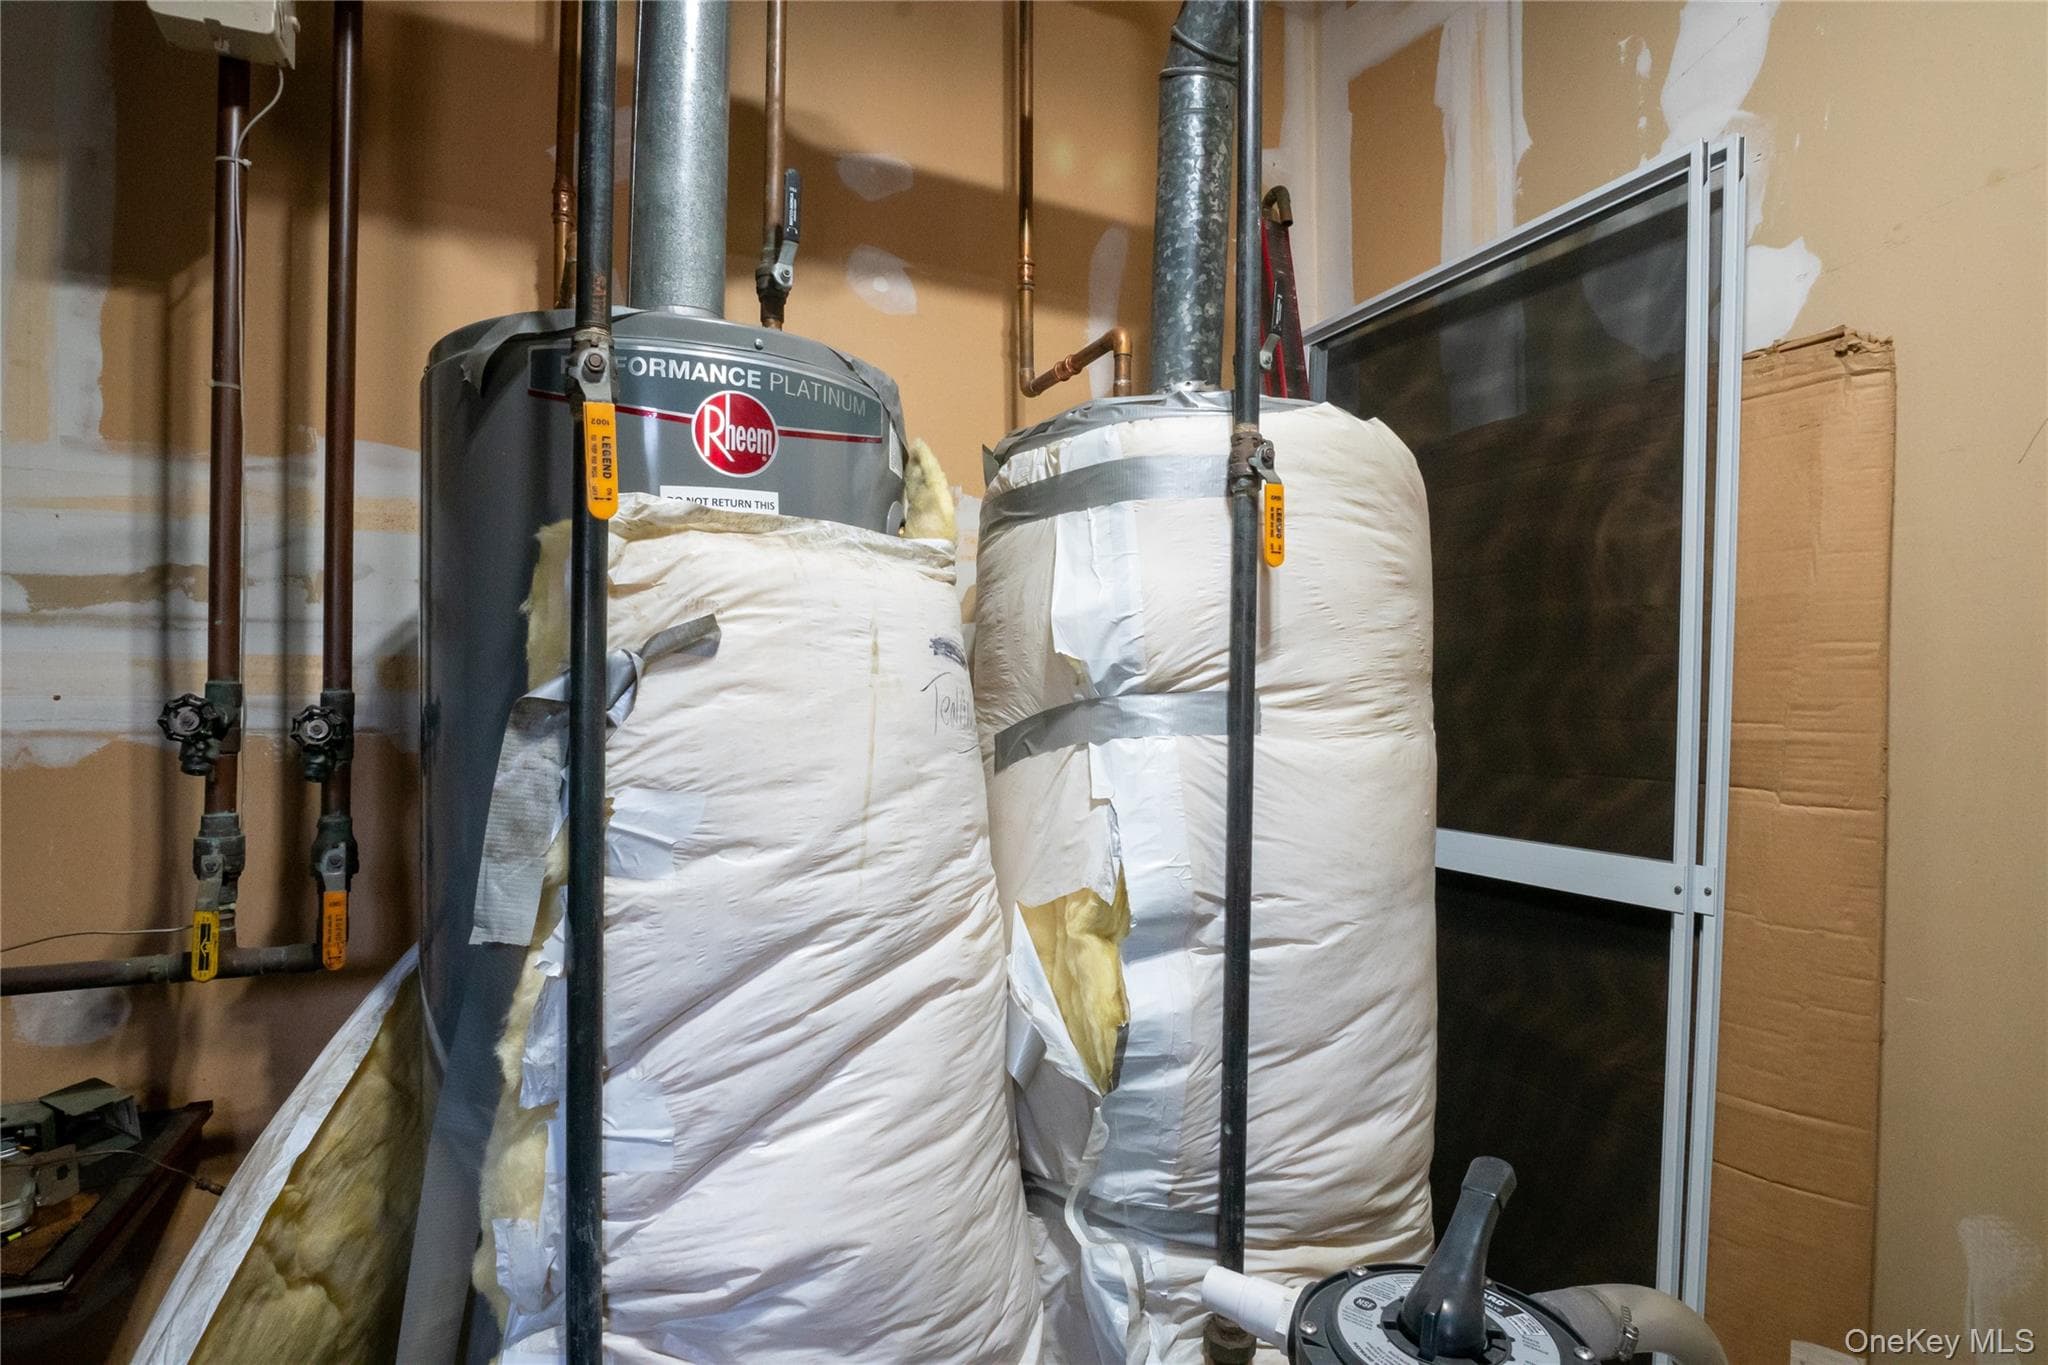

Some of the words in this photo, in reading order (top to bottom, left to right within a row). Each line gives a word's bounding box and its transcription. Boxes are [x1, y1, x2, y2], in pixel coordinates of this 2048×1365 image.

[770, 372, 866, 417] PLATINUM
[704, 390, 773, 463] Rheem
[602, 435, 612, 479] LEGEND
[712, 498, 752, 508] RETURN
[755, 500, 775, 511] THIS
[1355, 1298, 1376, 1309] NSF
